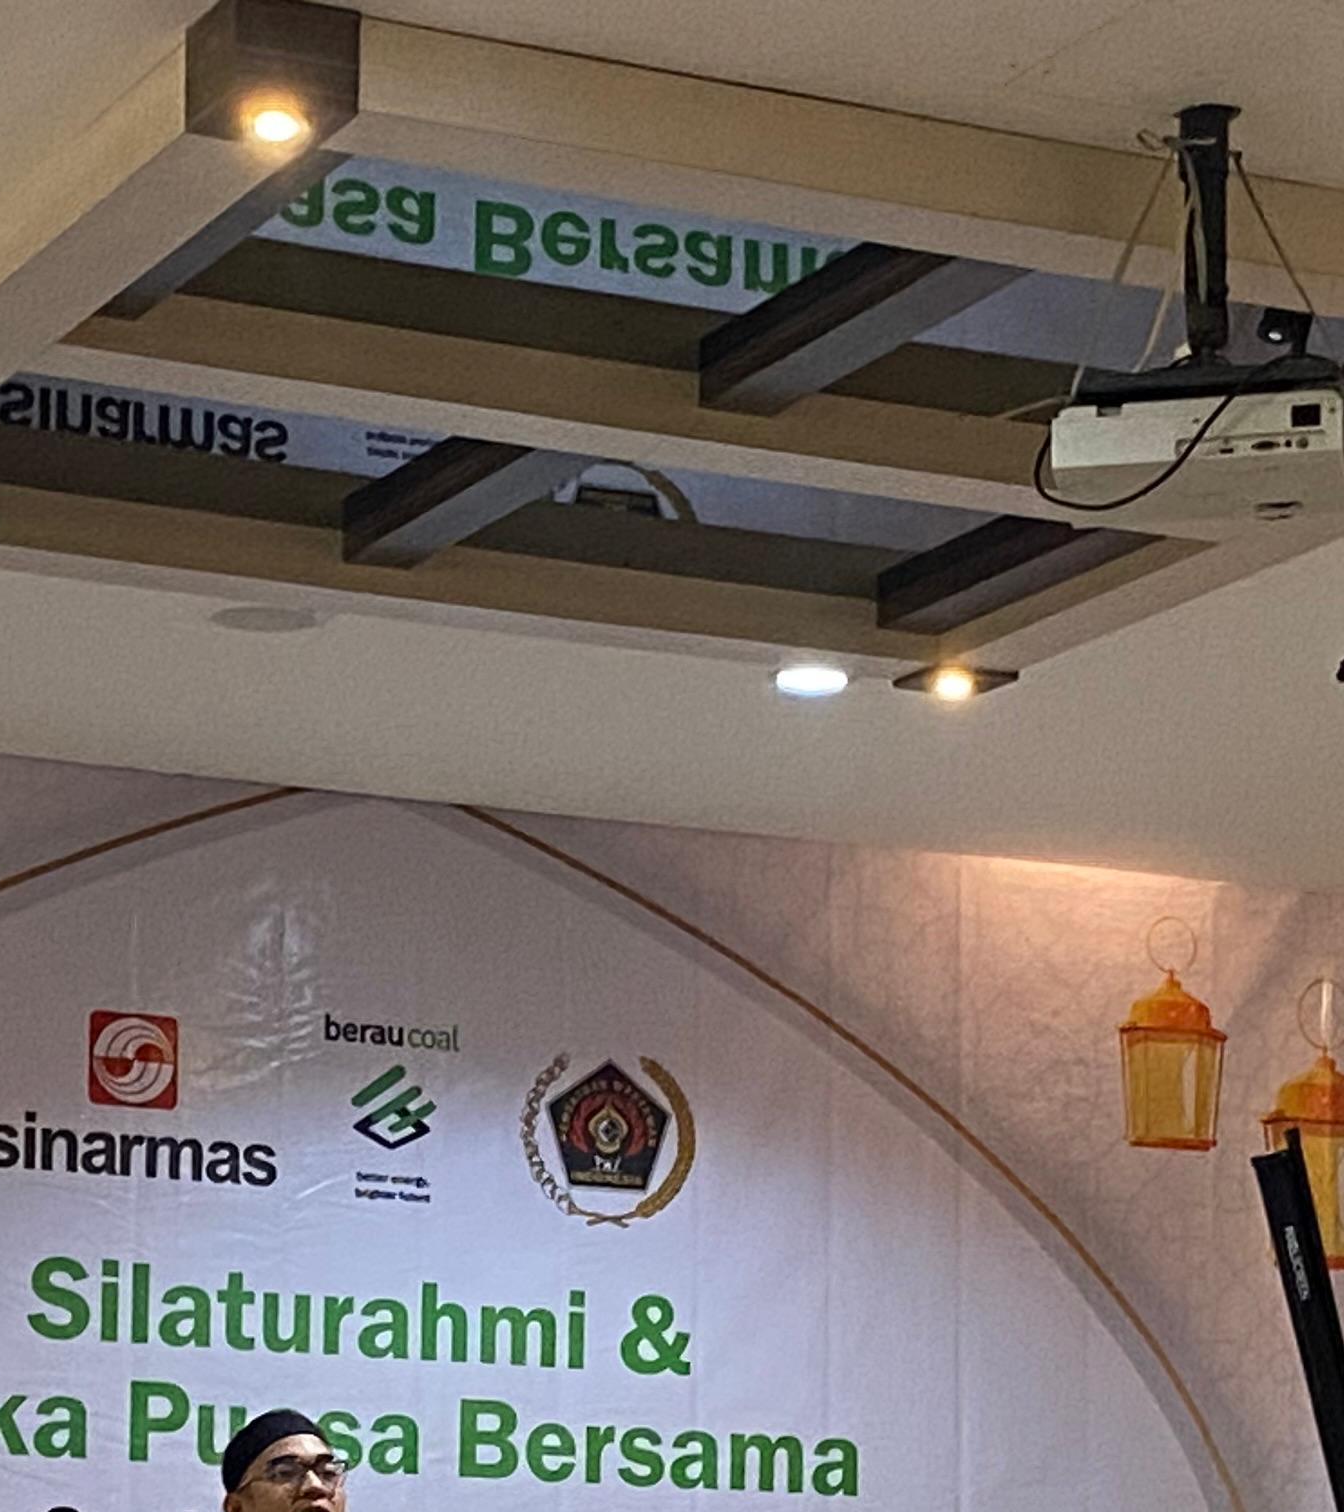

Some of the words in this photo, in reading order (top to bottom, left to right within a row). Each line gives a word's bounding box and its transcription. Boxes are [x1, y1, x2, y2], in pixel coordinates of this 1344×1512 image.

[27, 1255, 587, 1370] Silaturahmi
[619, 1292, 691, 1376] &
[129, 1380, 420, 1475] Pusa
[457, 1397, 860, 1497] Bersama
